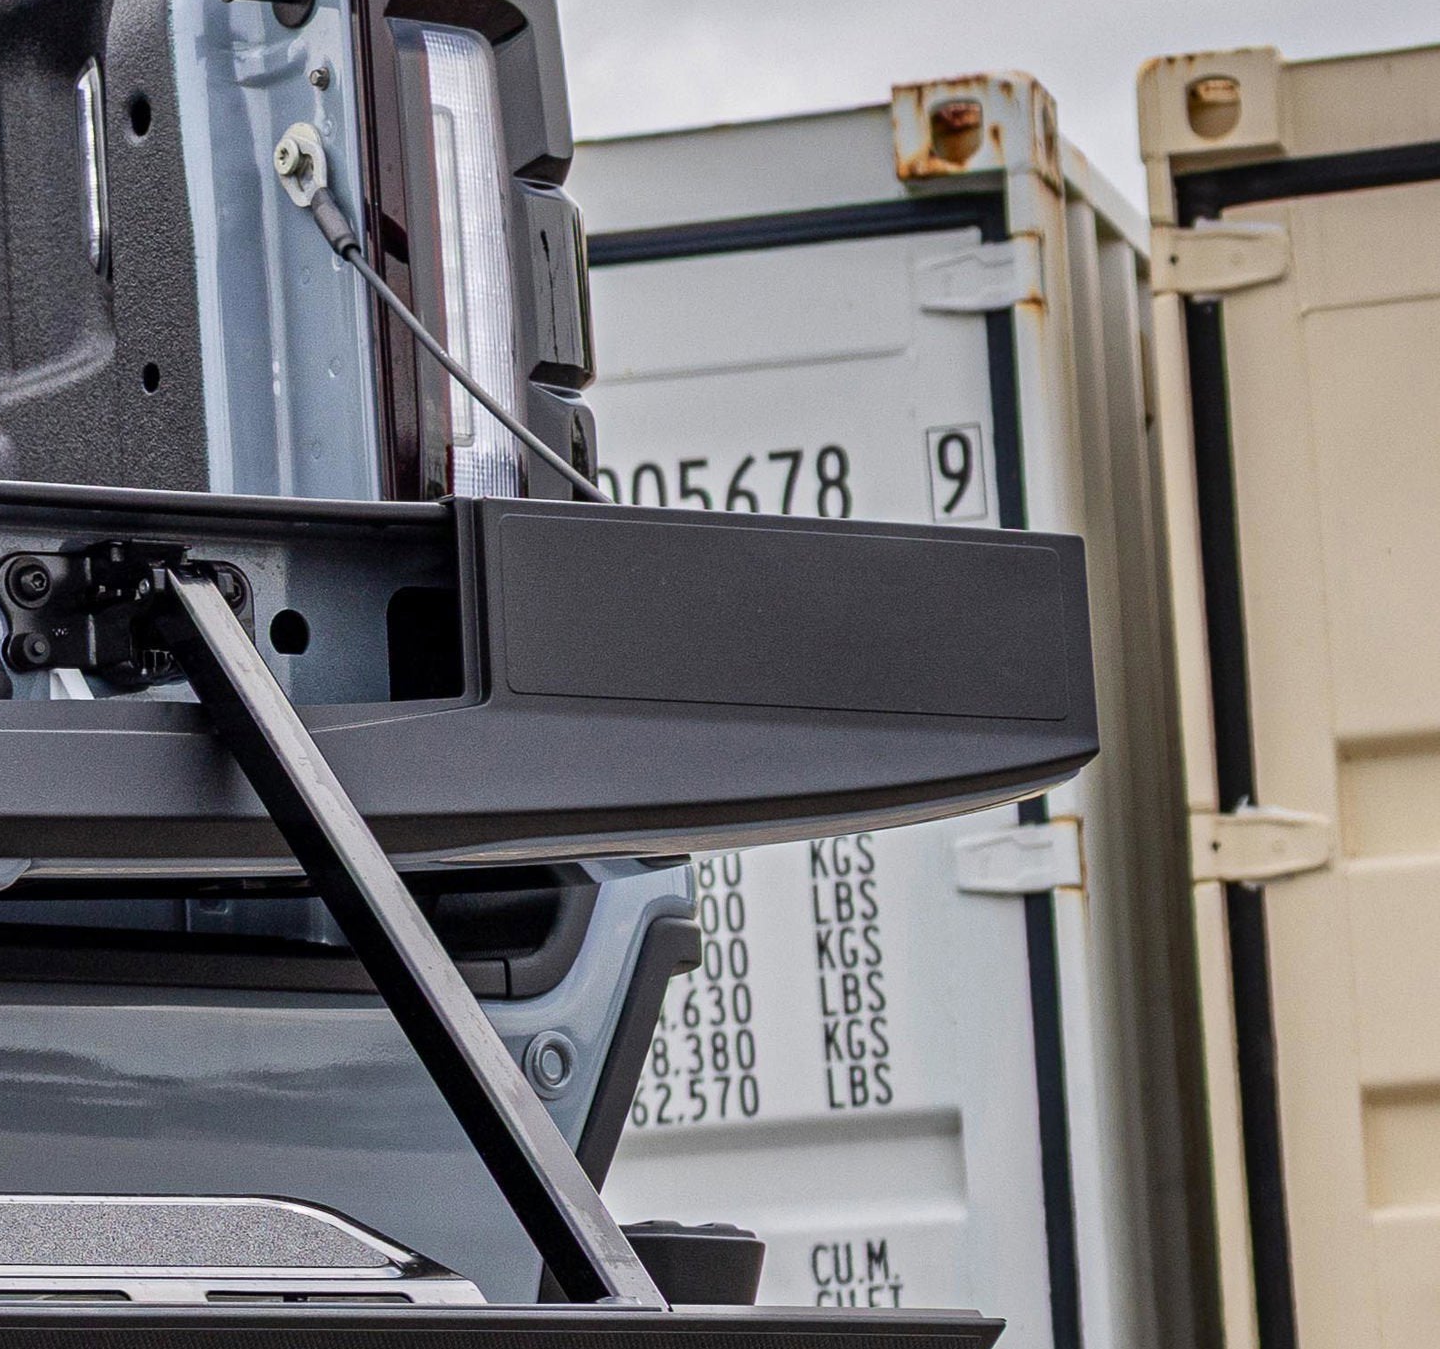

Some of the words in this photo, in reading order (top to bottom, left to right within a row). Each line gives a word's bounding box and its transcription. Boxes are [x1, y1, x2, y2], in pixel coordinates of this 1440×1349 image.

[936, 432, 974, 514] 9
[810, 832, 876, 878] KGS
[812, 879, 879, 925] LBS
[816, 925, 883, 970] KGS
[820, 970, 887, 1017] LBS
[823, 1016, 890, 1062] KGS
[631, 1074, 760, 1127] 62.570
[827, 1063, 894, 1110] LBS
